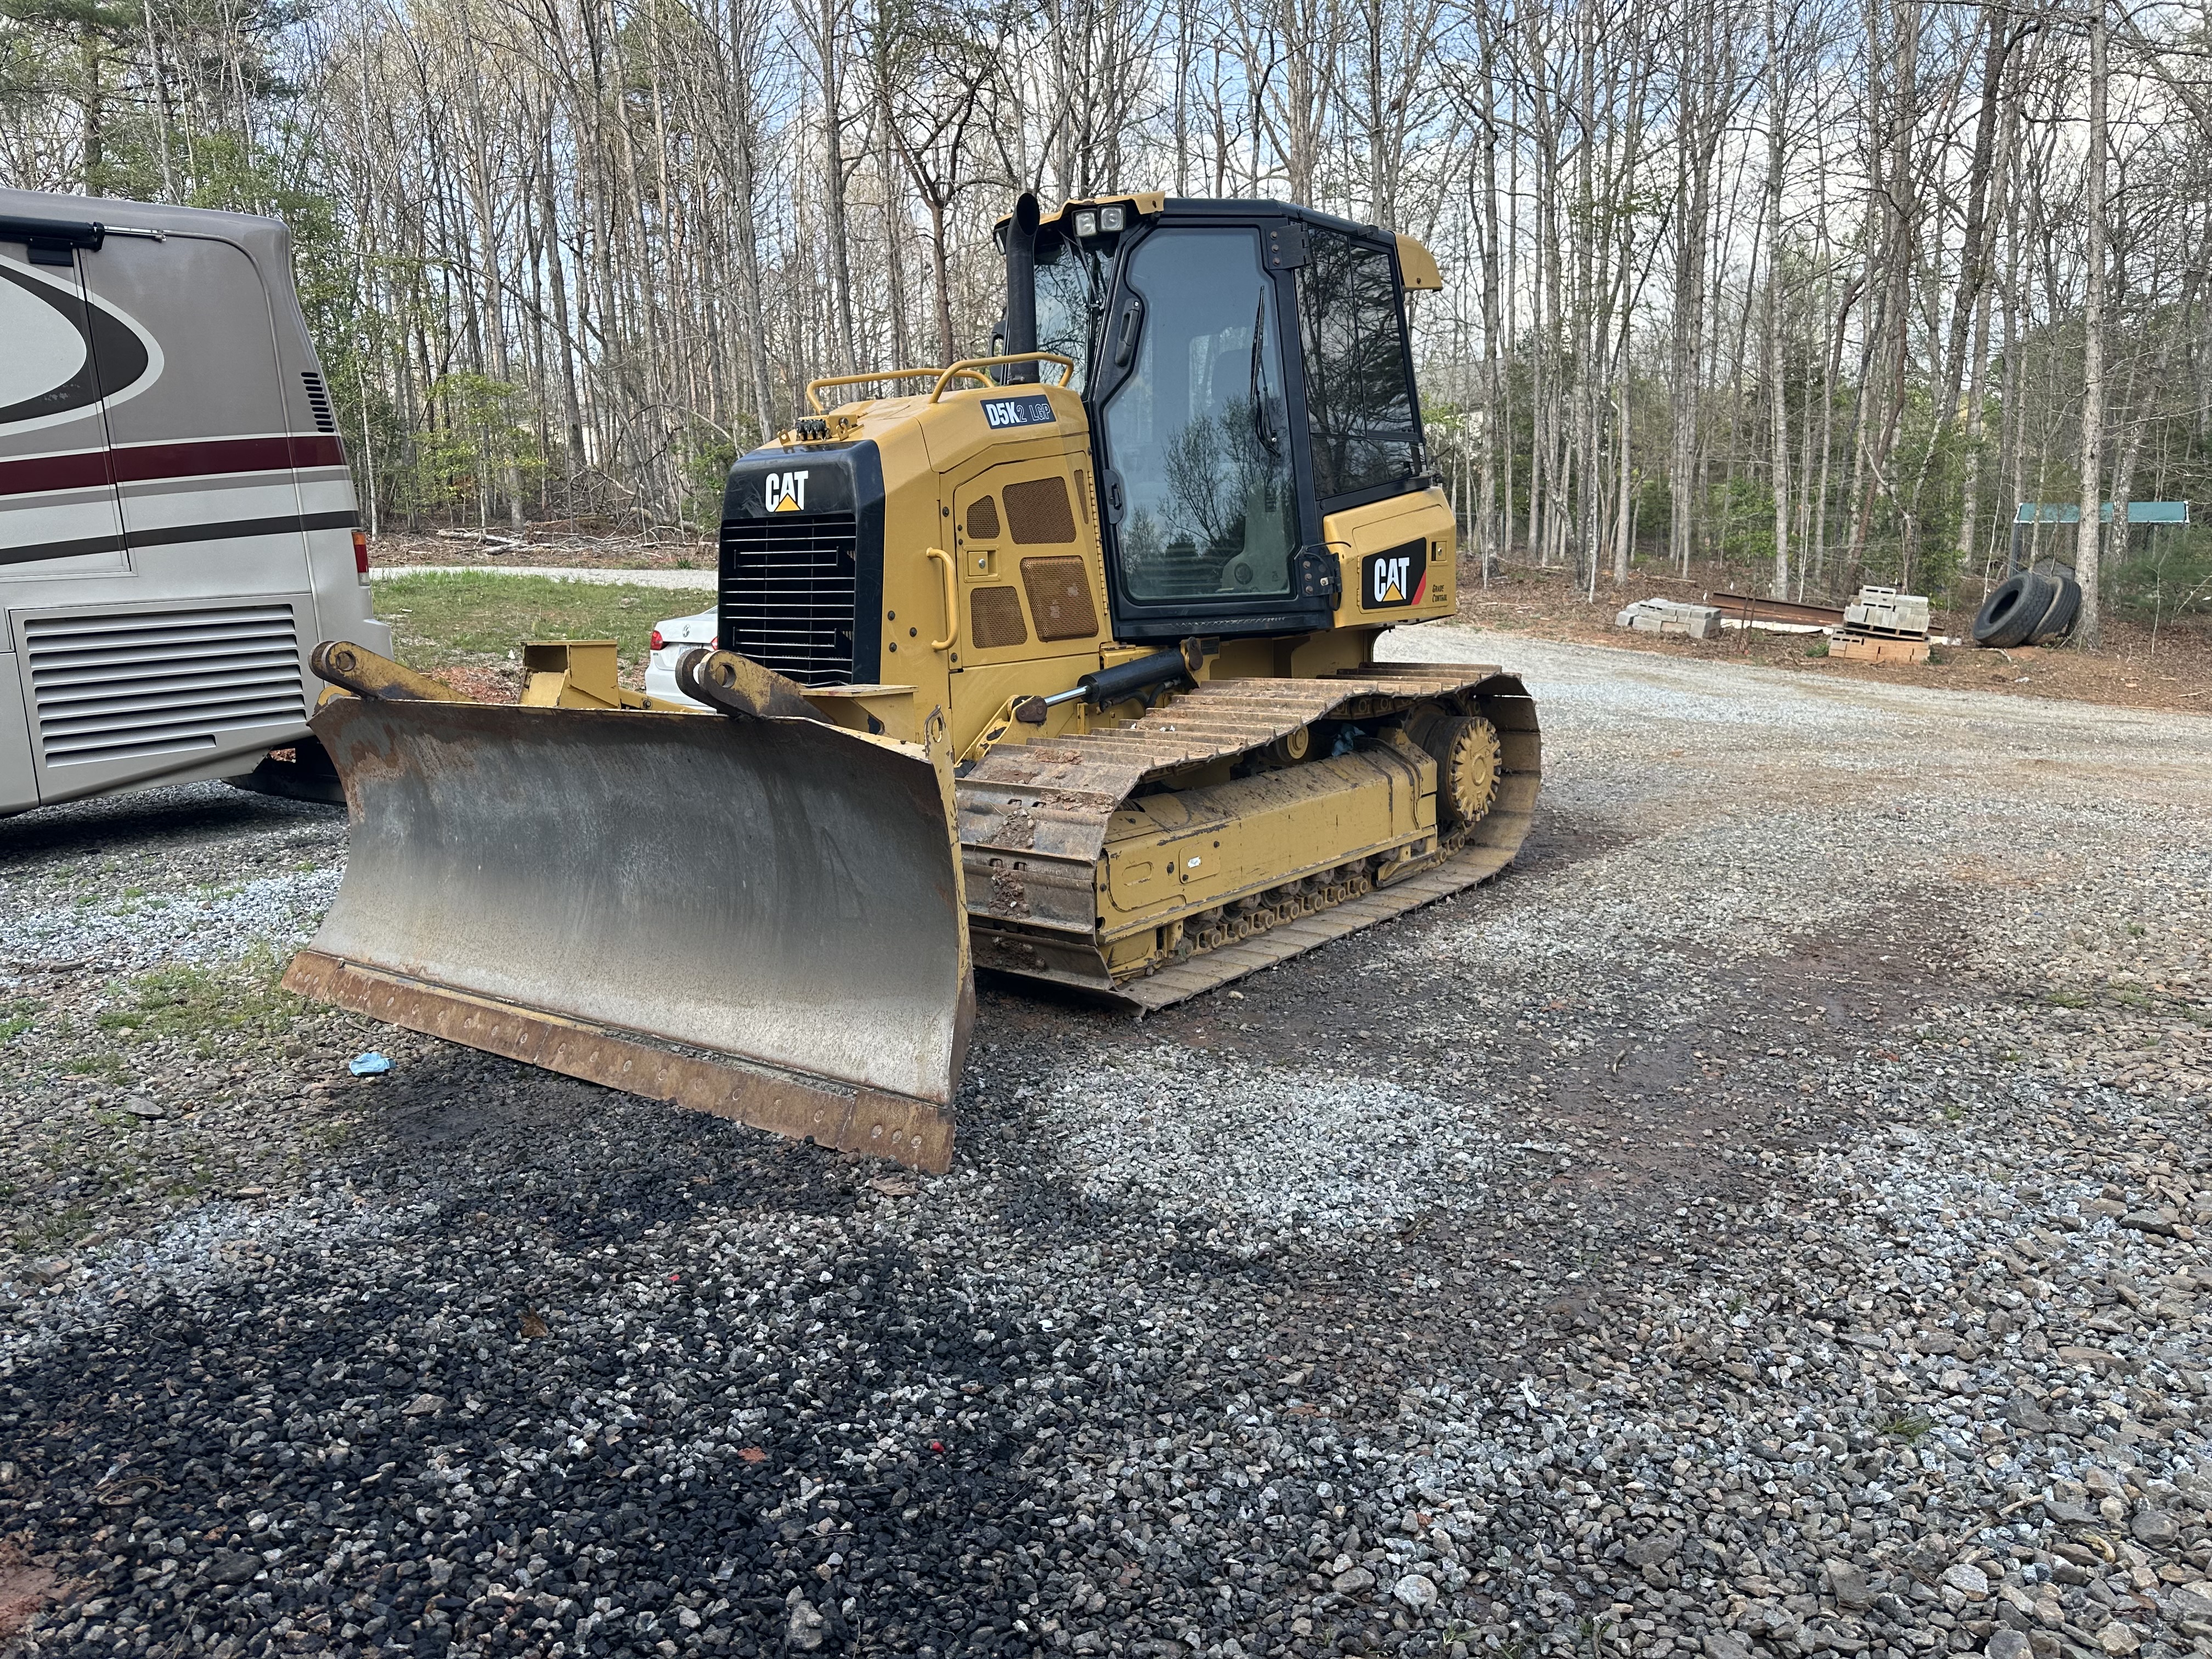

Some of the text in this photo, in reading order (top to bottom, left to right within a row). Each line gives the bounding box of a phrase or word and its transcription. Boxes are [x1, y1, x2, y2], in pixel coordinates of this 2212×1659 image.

[985, 401, 1051, 426] D5K2 LGP
[765, 470, 809, 512] CAT
[1374, 556, 1410, 602] CAT
